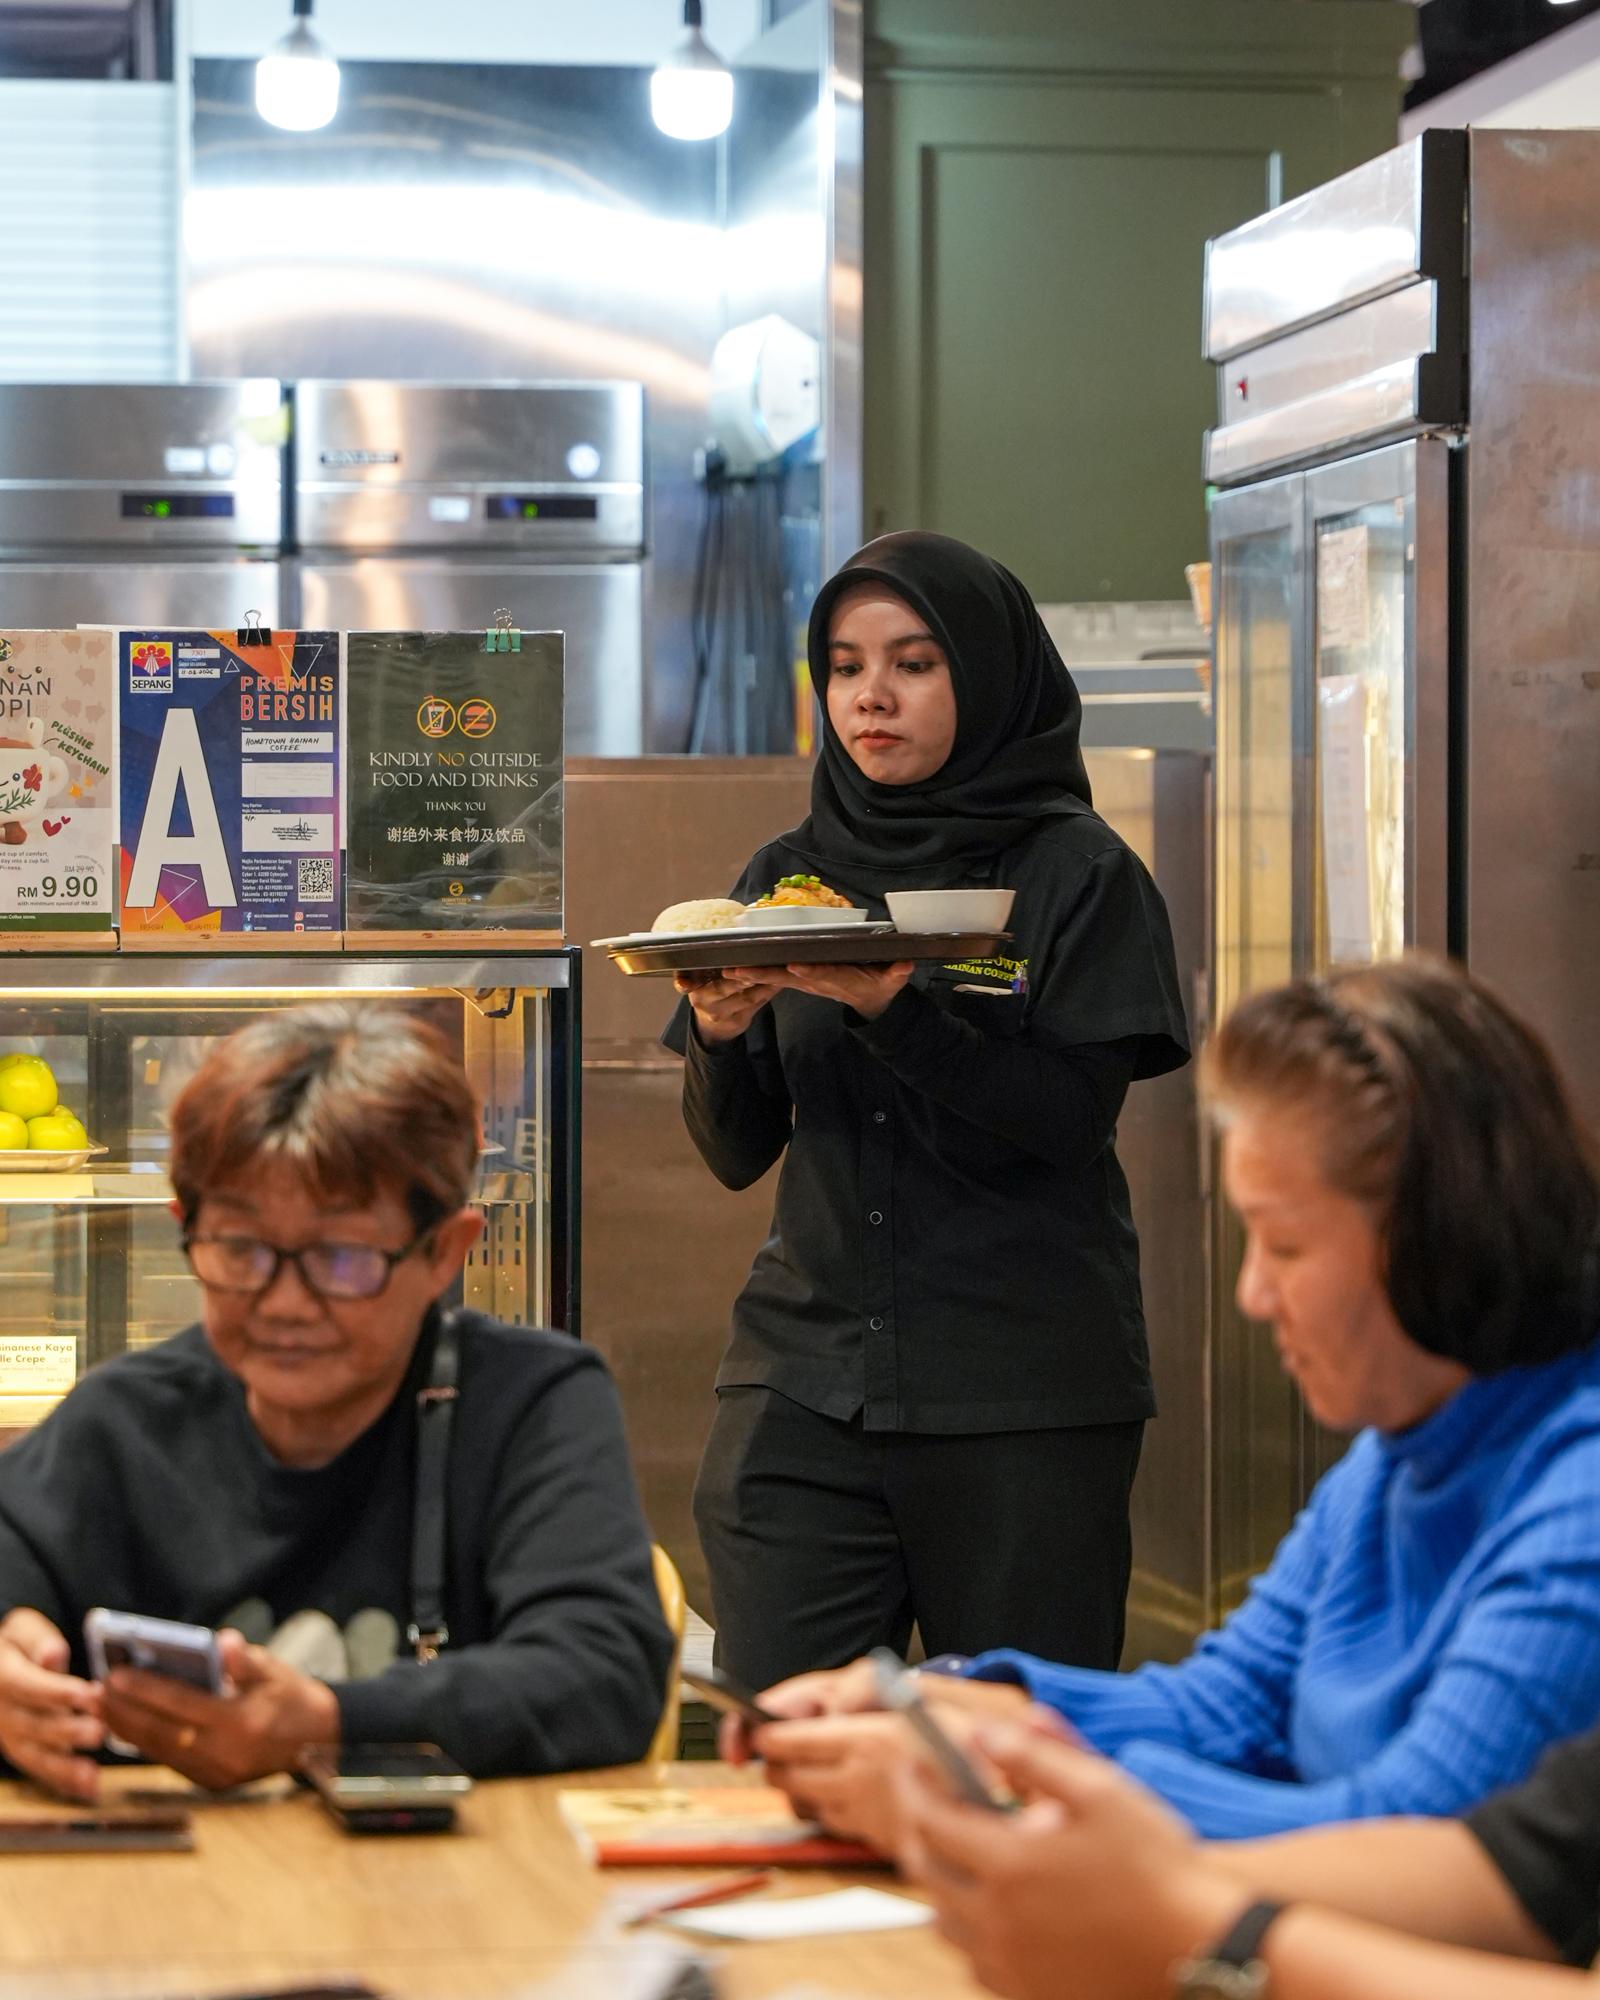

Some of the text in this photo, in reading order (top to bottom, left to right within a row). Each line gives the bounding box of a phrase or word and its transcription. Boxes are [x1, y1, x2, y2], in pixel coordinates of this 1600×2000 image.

[132, 680, 171, 688] SEPANG
[241, 676, 334, 691] PREMIS
[241, 694, 332, 721] BERSIH
[245, 738, 286, 746] HOMETOWN
[270, 744, 300, 752] COFFEE
[57, 740, 110, 775] KEYCHAIN
[370, 752, 542, 766] KINDLY NO OUTSIDE
[373, 772, 538, 787] FOOD AND DRINKS
[124, 707, 238, 908] A
[425, 802, 486, 811] THANK YOU
[387, 827, 526, 843] 谢绝外来食物及饮品
[442, 852, 469, 866] 谢谢
[17, 876, 98, 898] RM 9.90
[46, 1344, 73, 1354] Kaya
[16, 1354, 46, 1365] Crepe
